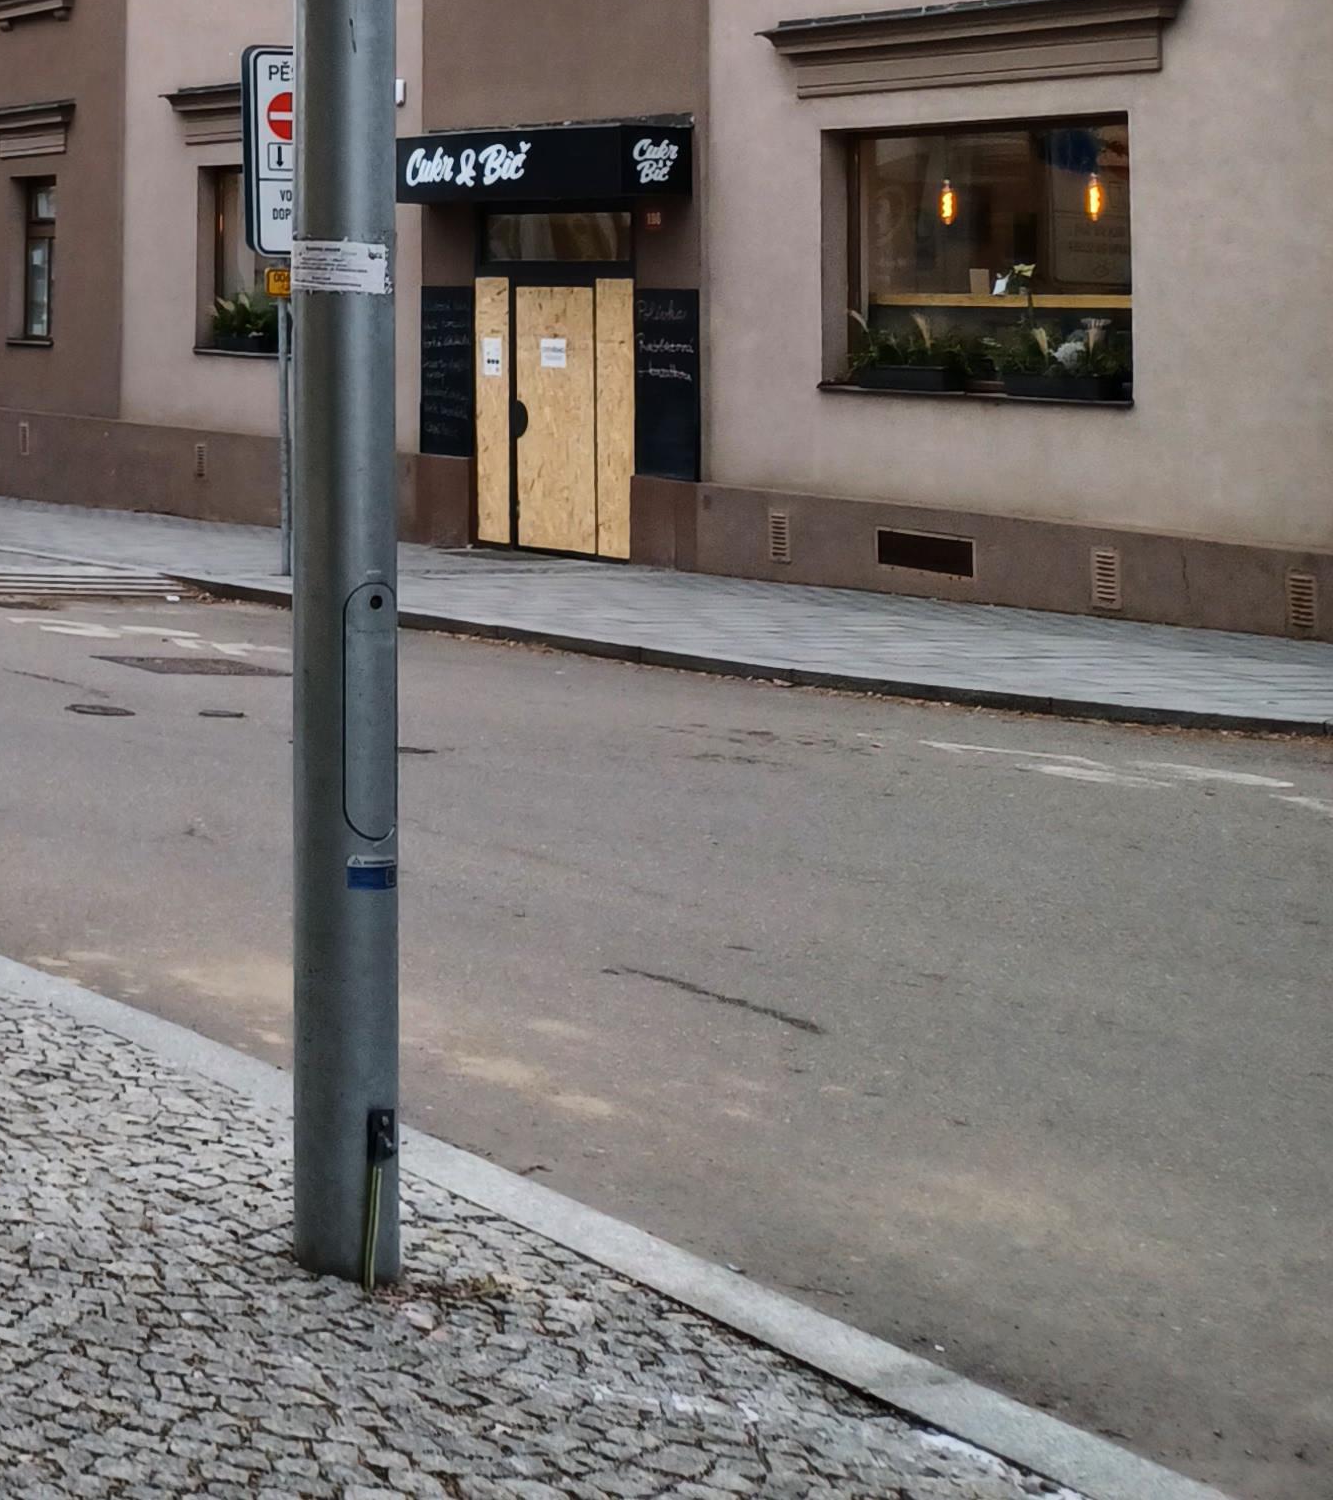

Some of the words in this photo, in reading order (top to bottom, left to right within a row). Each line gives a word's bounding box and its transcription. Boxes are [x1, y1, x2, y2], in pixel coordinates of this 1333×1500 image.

[268, 60, 293, 82] PĚ
[632, 138, 679, 161] Cukr
[406, 146, 455, 188] Cukr
